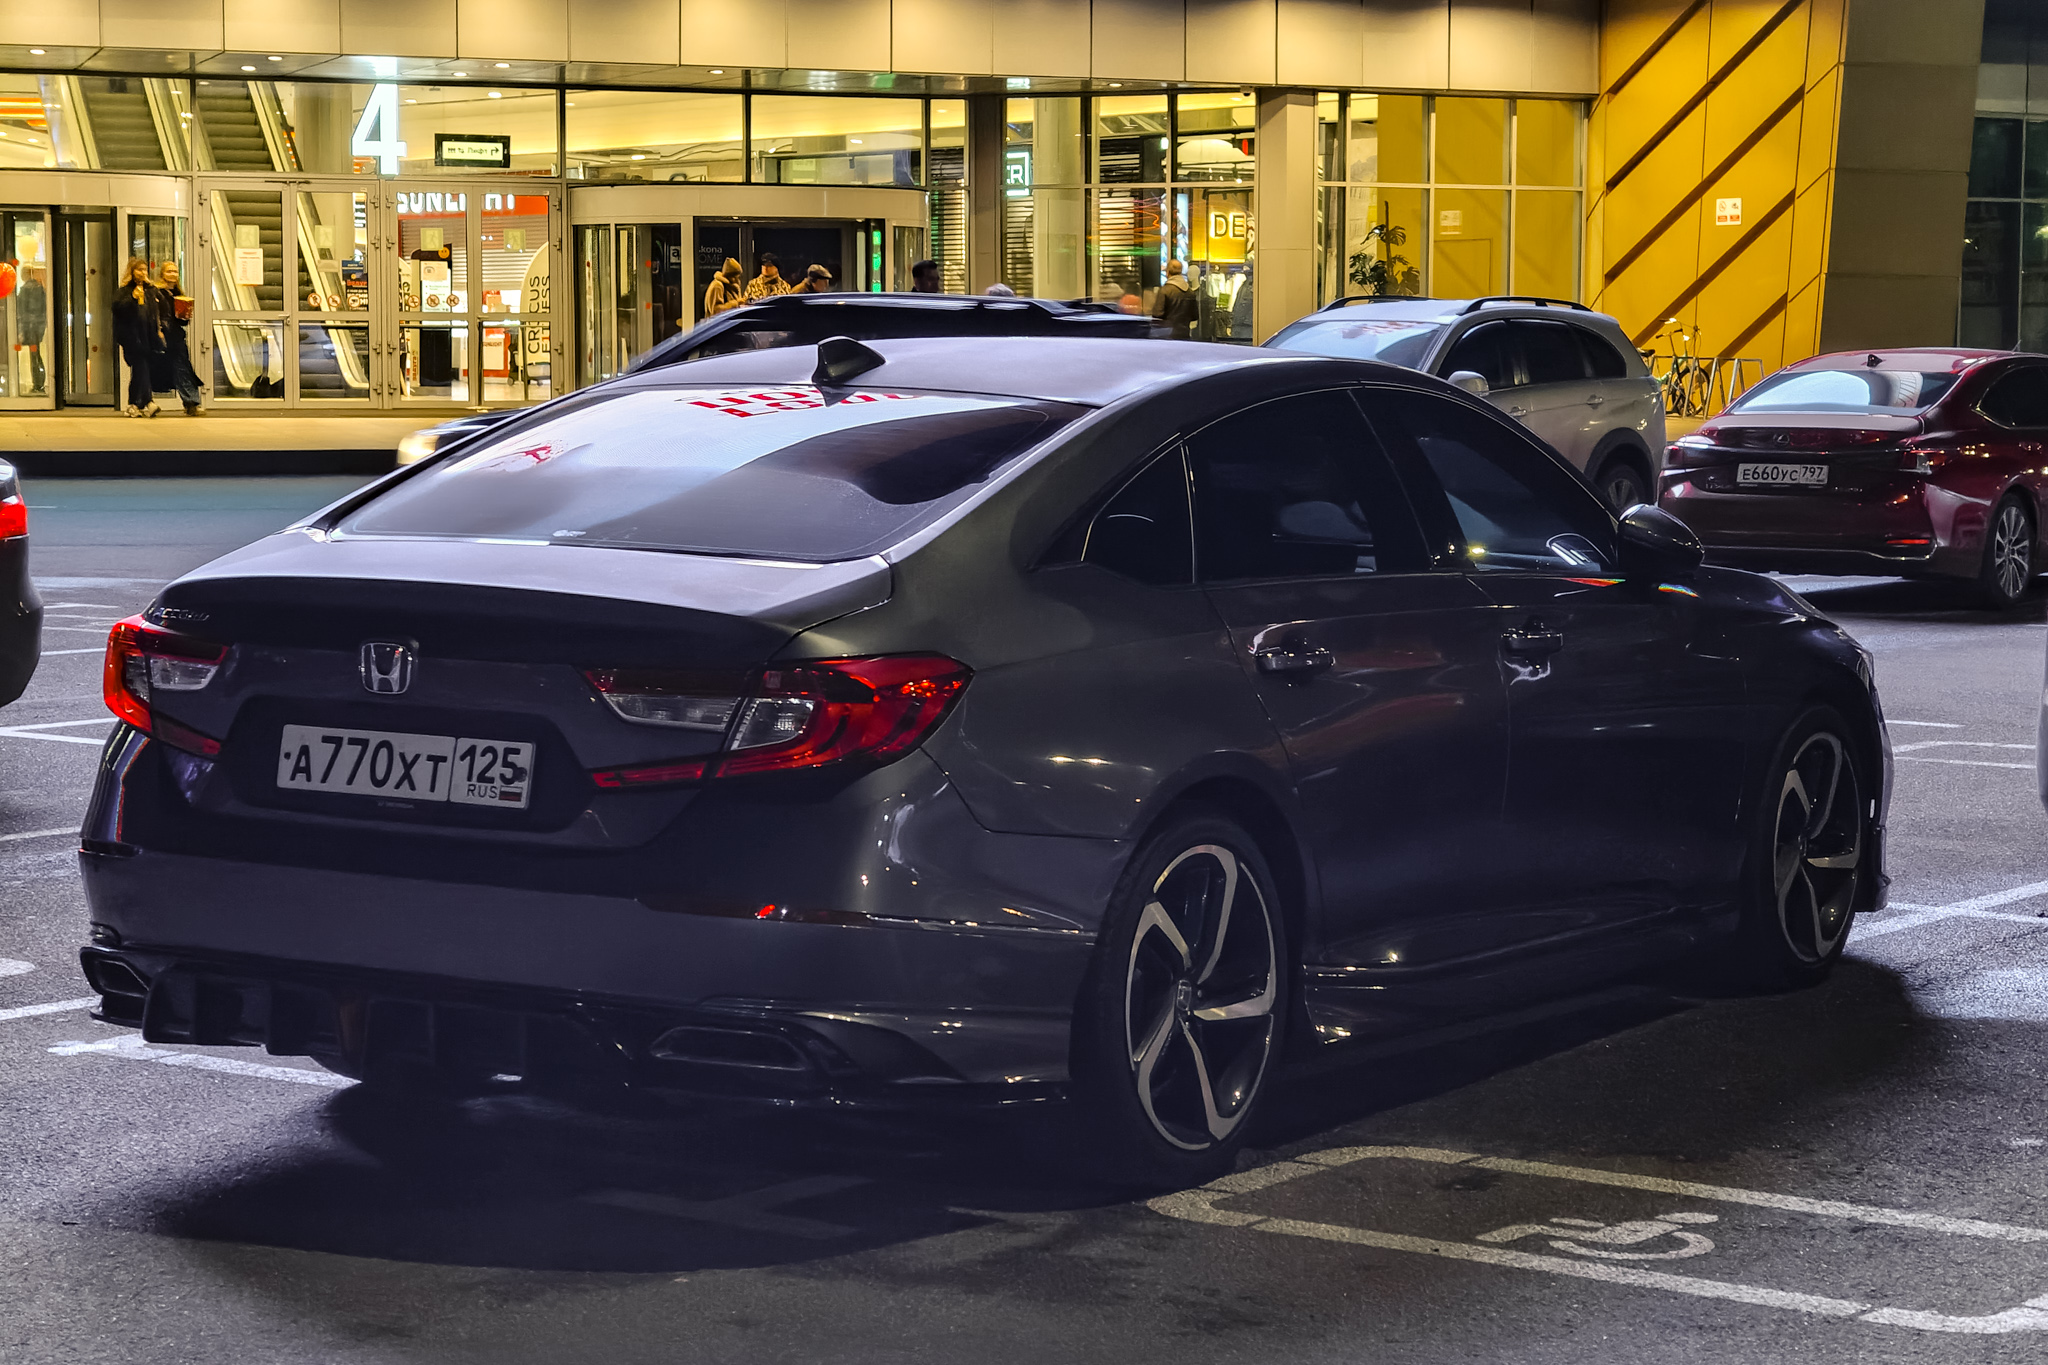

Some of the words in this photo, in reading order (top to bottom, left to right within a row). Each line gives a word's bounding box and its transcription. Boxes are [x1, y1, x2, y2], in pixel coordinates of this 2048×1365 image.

[350, 83, 407, 176] 4
[1802, 466, 1824, 479] 797
[459, 744, 524, 785] 125
[466, 784, 498, 799] RUS
